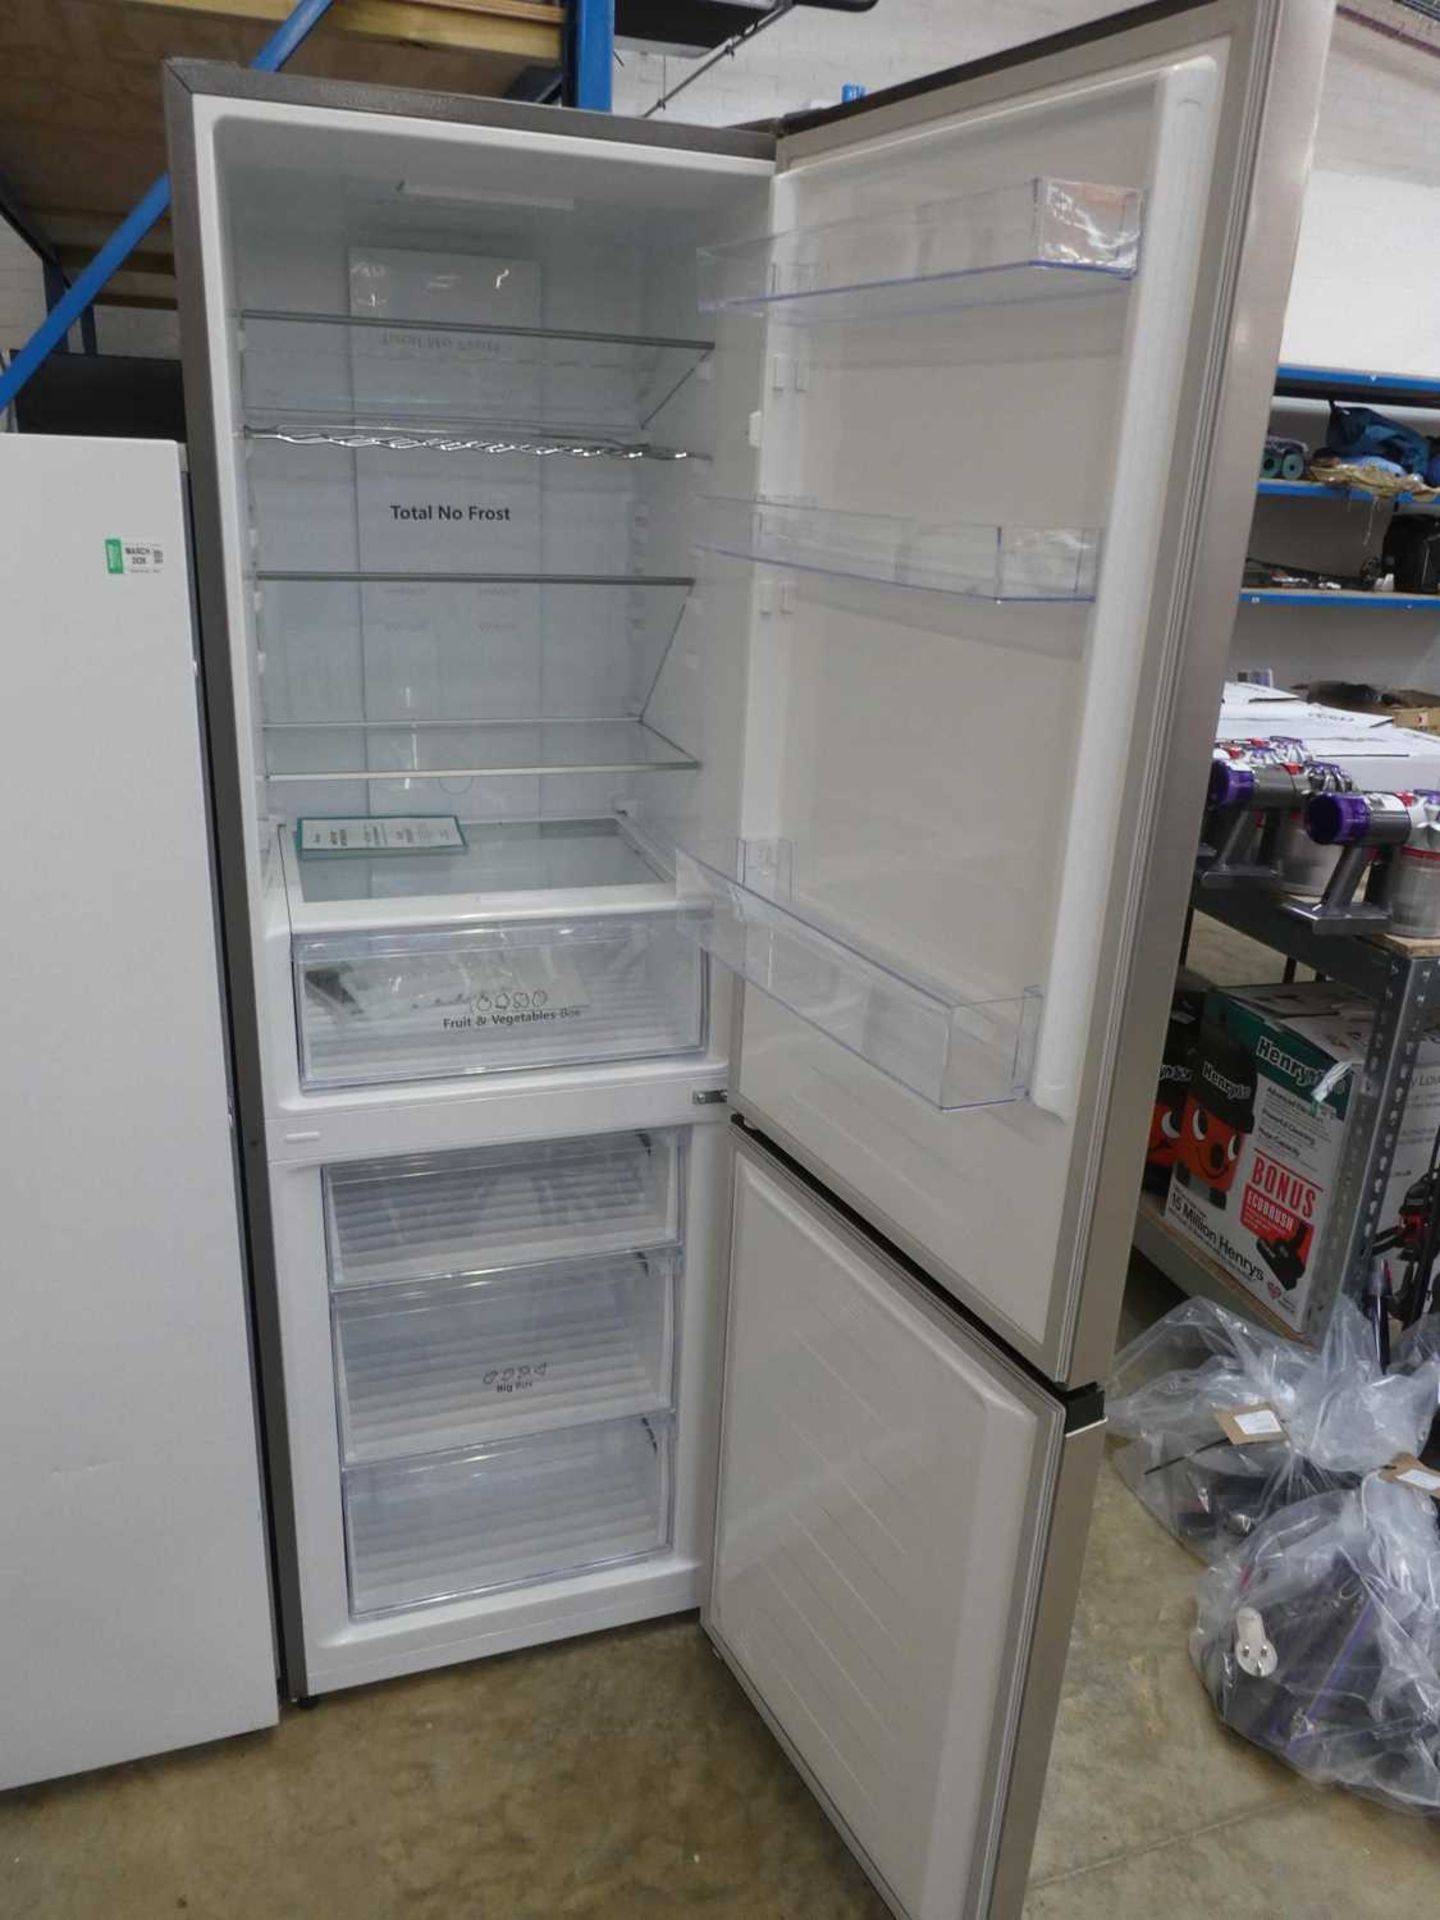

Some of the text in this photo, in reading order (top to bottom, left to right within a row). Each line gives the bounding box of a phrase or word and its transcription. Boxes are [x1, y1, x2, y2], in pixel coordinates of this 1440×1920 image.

[390, 505, 511, 520] Total No Frost
[443, 1018, 471, 1029] Fruit
[476, 1017, 487, 1026] &
[492, 1011, 556, 1026] Vegetables
[1252, 1157, 1315, 1218] BONUS
[1171, 1193, 1183, 1210] 15
[1182, 1203, 1217, 1244] Million
[1219, 1236, 1265, 1281] Henrys
